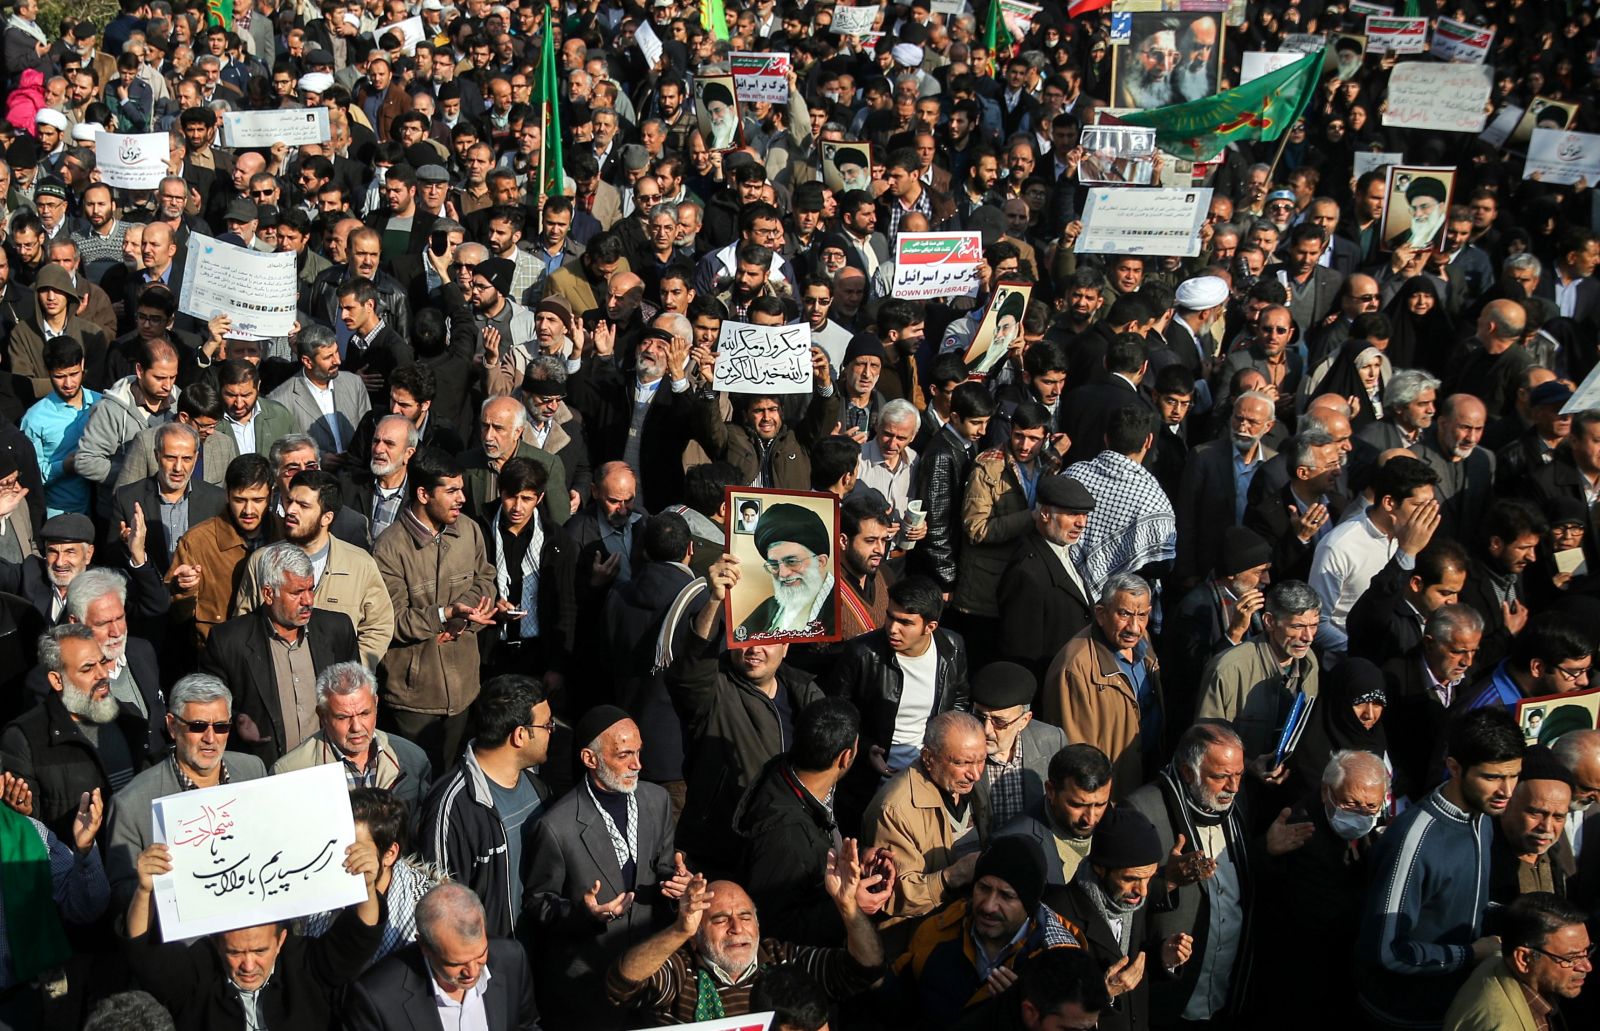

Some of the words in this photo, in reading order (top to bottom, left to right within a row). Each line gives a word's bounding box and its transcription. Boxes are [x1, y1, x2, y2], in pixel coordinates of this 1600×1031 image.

[761, 82, 767, 92] بر
[768, 81, 786, 92] مرگ
[898, 268, 939, 285] اسرائیل
[939, 272, 951, 284] بر
[953, 268, 979, 282] مرگ
[895, 289, 920, 297] DOWN
[922, 287, 943, 296] WITH
[944, 285, 973, 294] ISRAEL
[721, 329, 739, 350] الله
[174, 804, 234, 847] شهادت
